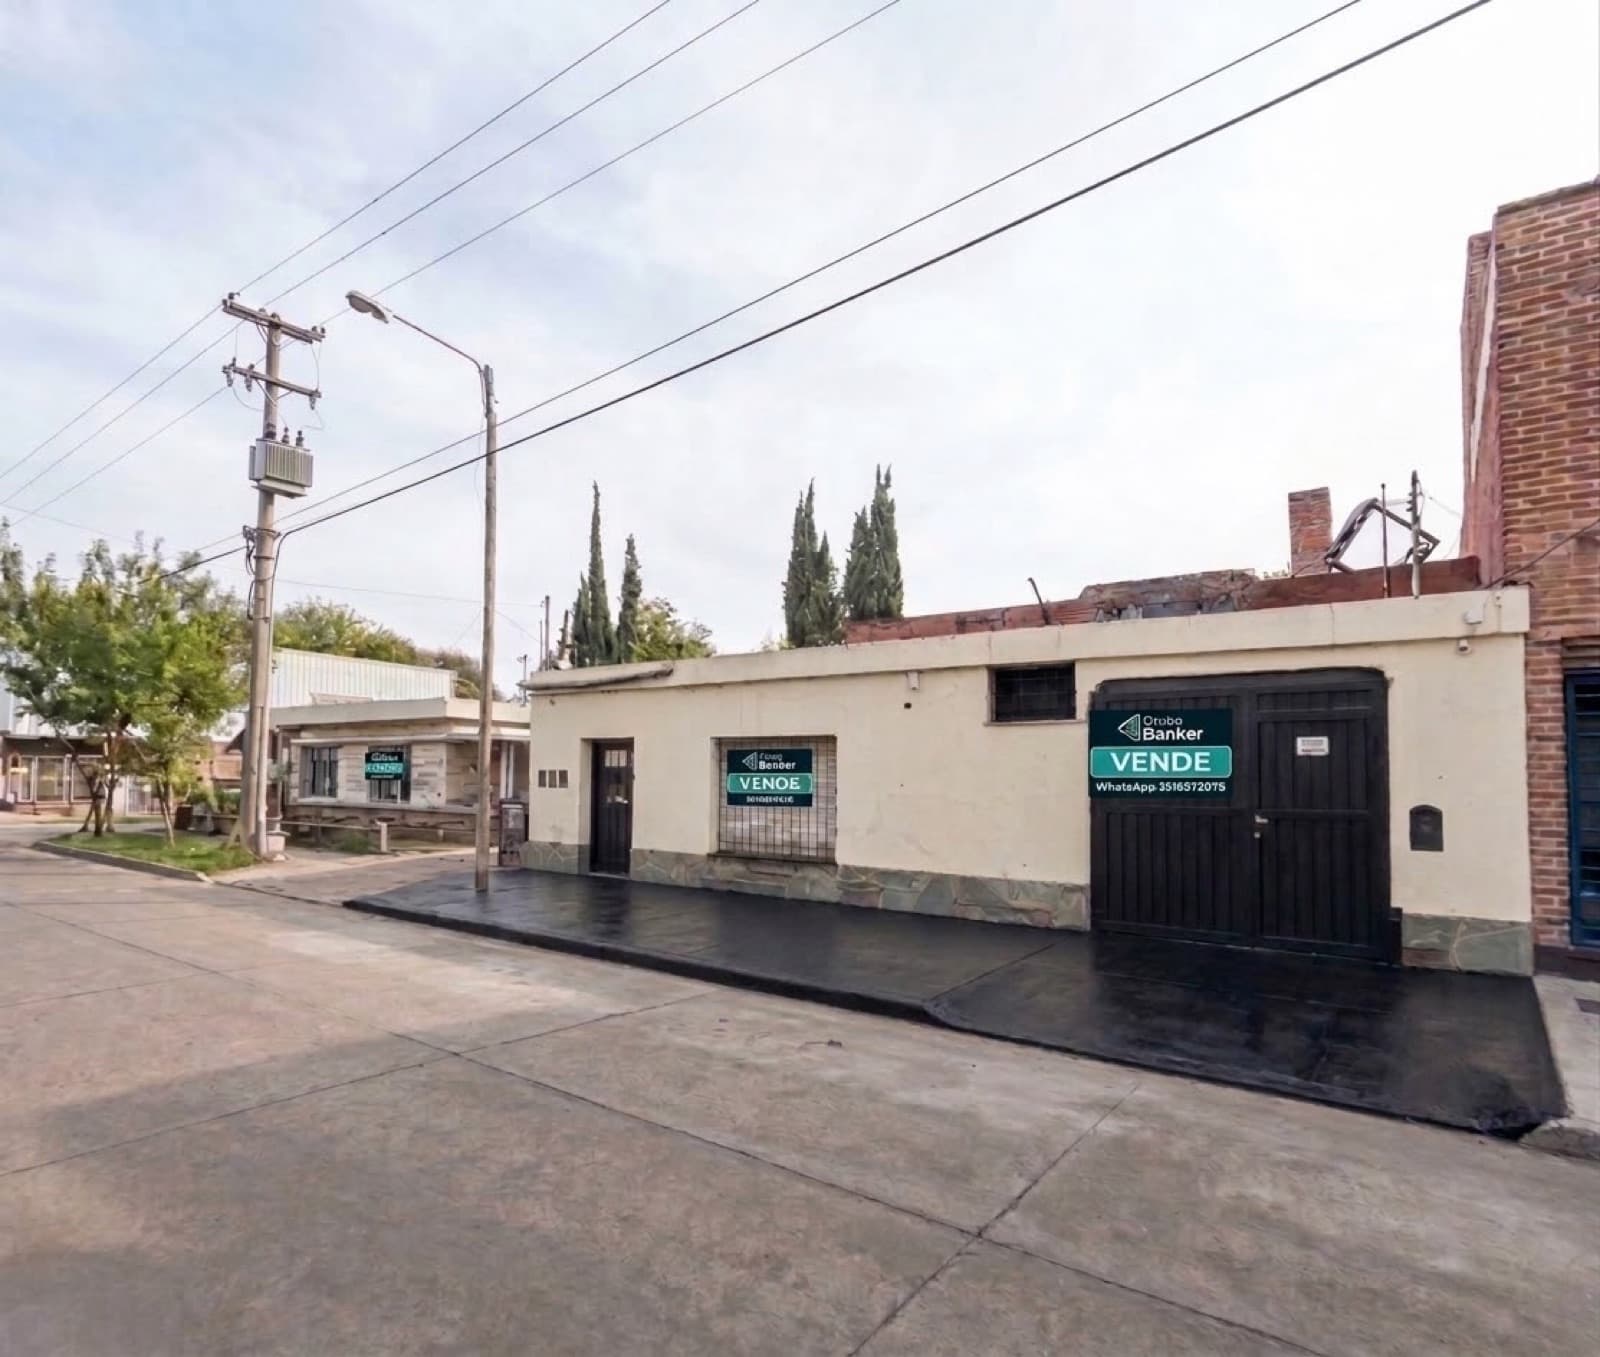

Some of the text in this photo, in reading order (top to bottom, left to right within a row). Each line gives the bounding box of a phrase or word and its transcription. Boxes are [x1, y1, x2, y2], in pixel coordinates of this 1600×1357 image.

[1143, 727, 1204, 741] Banker
[1110, 751, 1211, 772] VENDE
[1096, 782, 1155, 794] WhatsApp
